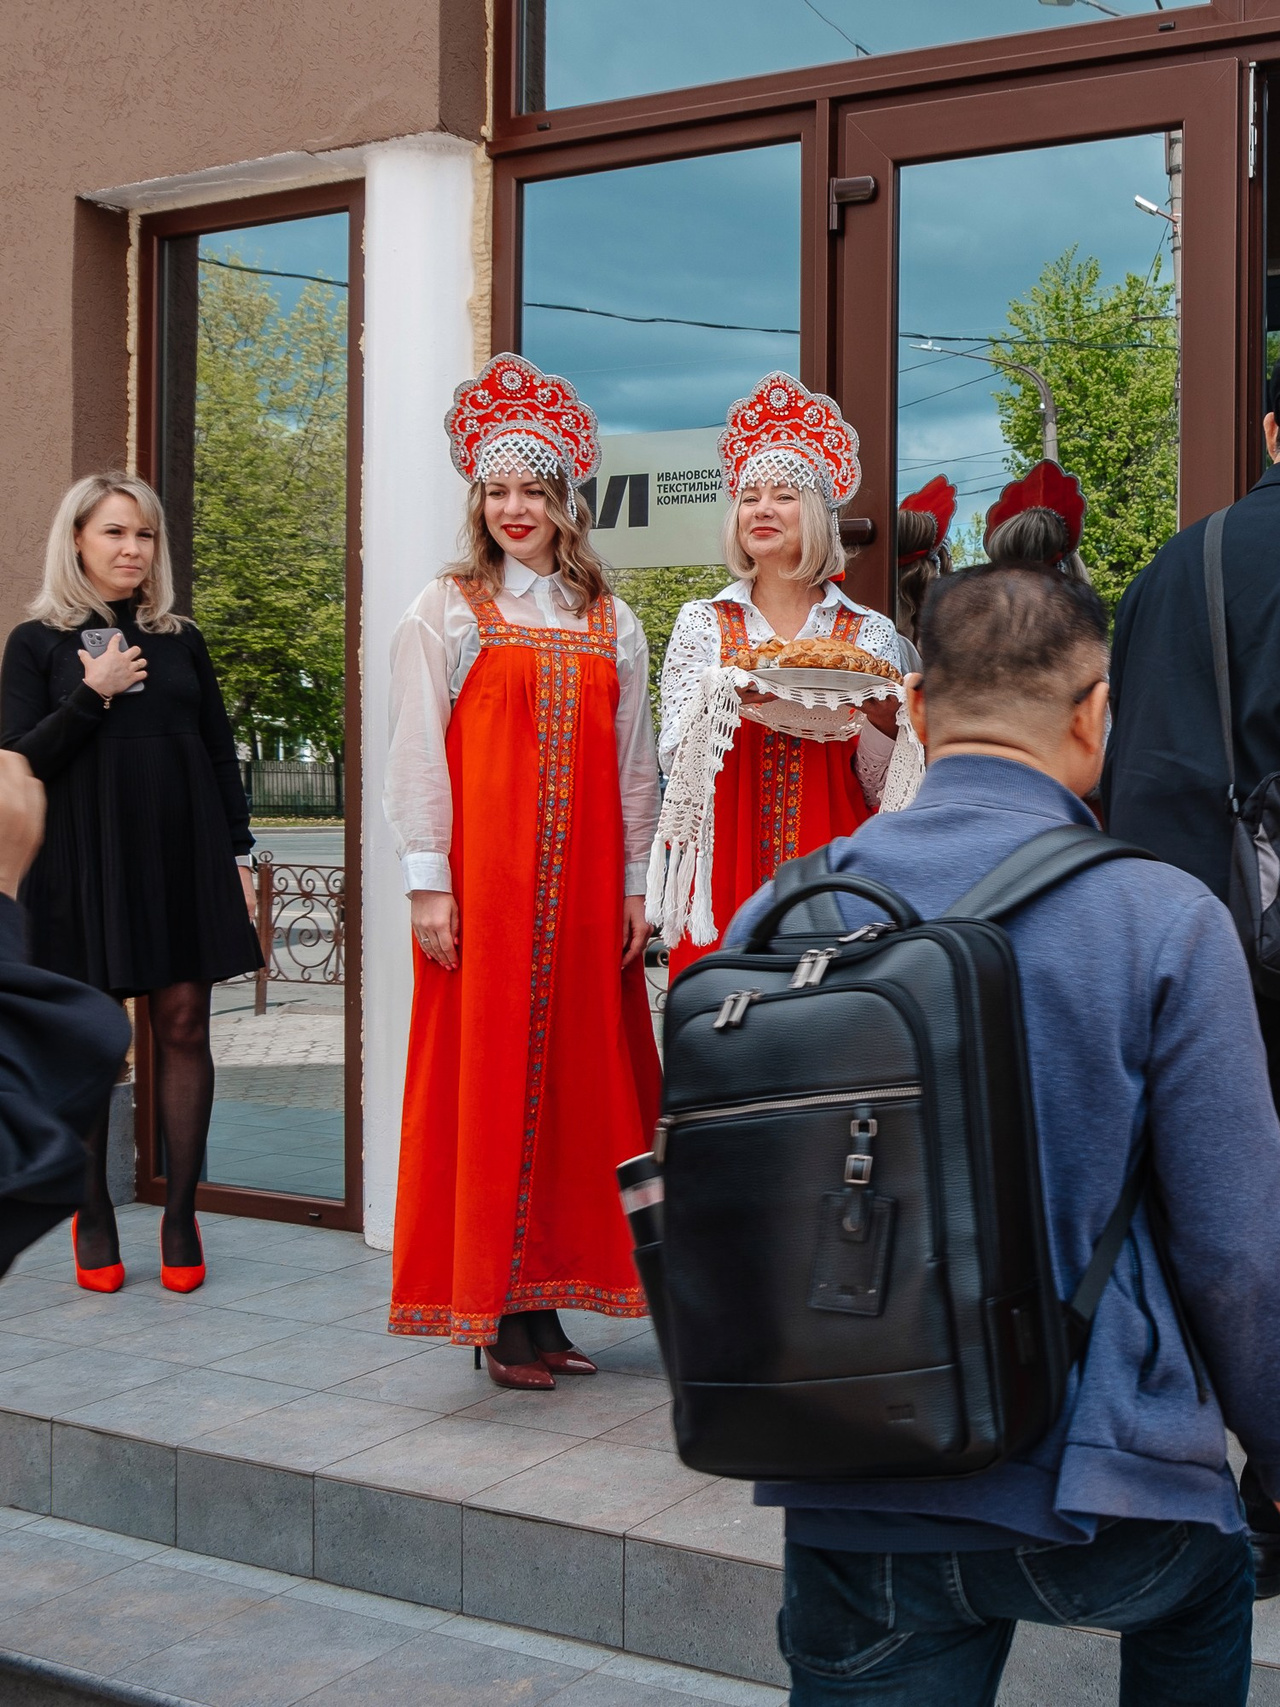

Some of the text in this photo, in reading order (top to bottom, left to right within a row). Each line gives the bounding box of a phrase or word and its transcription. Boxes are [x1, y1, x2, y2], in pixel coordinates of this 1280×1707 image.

[657, 468, 721, 482] ИВАНОВСКА
[657, 480, 723, 494] ТЕКСТИЛЬНА
[656, 493, 717, 506] КОМПАНИЯ
